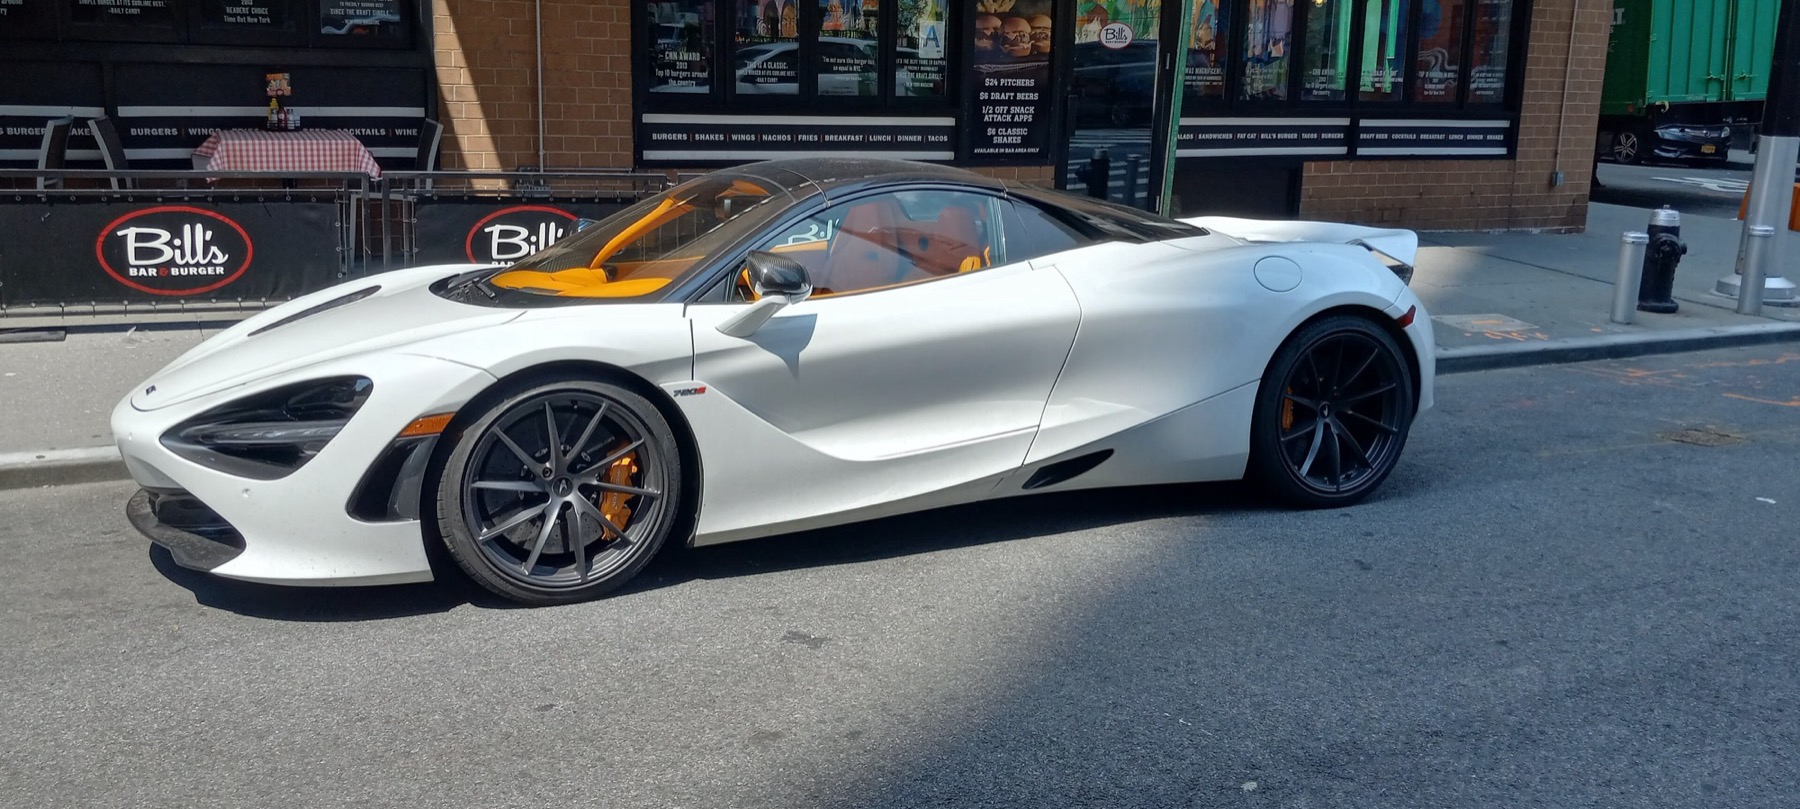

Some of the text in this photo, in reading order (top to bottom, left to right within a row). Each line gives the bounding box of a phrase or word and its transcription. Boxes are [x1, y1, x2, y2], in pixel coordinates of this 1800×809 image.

[923, 25, 940, 48] A
[1104, 27, 1128, 41] Bill's
[679, 51, 701, 61] AWARD
[676, 61, 688, 70] 2013
[655, 68, 664, 78] Top
[671, 69, 691, 79] burgers
[984, 77, 1035, 87] $24 PITCHERS
[979, 91, 1039, 101] $6 DRAFT BEERS
[982, 105, 1035, 114] 1/2 OFF SNACK
[983, 114, 1033, 122] ATTACK APPS
[130, 127, 178, 136] BURGERS
[395, 128, 418, 136] WINE
[987, 127, 1028, 136] $6 CLASSIC
[1198, 132, 1233, 140] SANDWICHES
[1237, 132, 1246, 140] FAT
[1277, 132, 1299, 140] BURGER
[1301, 132, 1318, 140] TACOS
[1320, 132, 1345, 140] BURGERS
[652, 133, 688, 141] BURGERS
[695, 133, 725, 141] SHAKES
[731, 134, 756, 142] WINGS
[762, 134, 792, 142] NACHOS
[798, 134, 818, 142] FRIES
[824, 134, 864, 142] BREAKFAST
[897, 135, 922, 143] DINNER
[928, 135, 948, 143] TACOS
[993, 136, 1022, 144] SHAKES
[1419, 133, 1446, 141] BREAKFAST
[116, 223, 229, 266] Bill's
[129, 267, 157, 277] BAR
[171, 266, 225, 277] BURGER
[673, 386, 707, 397] 720S
